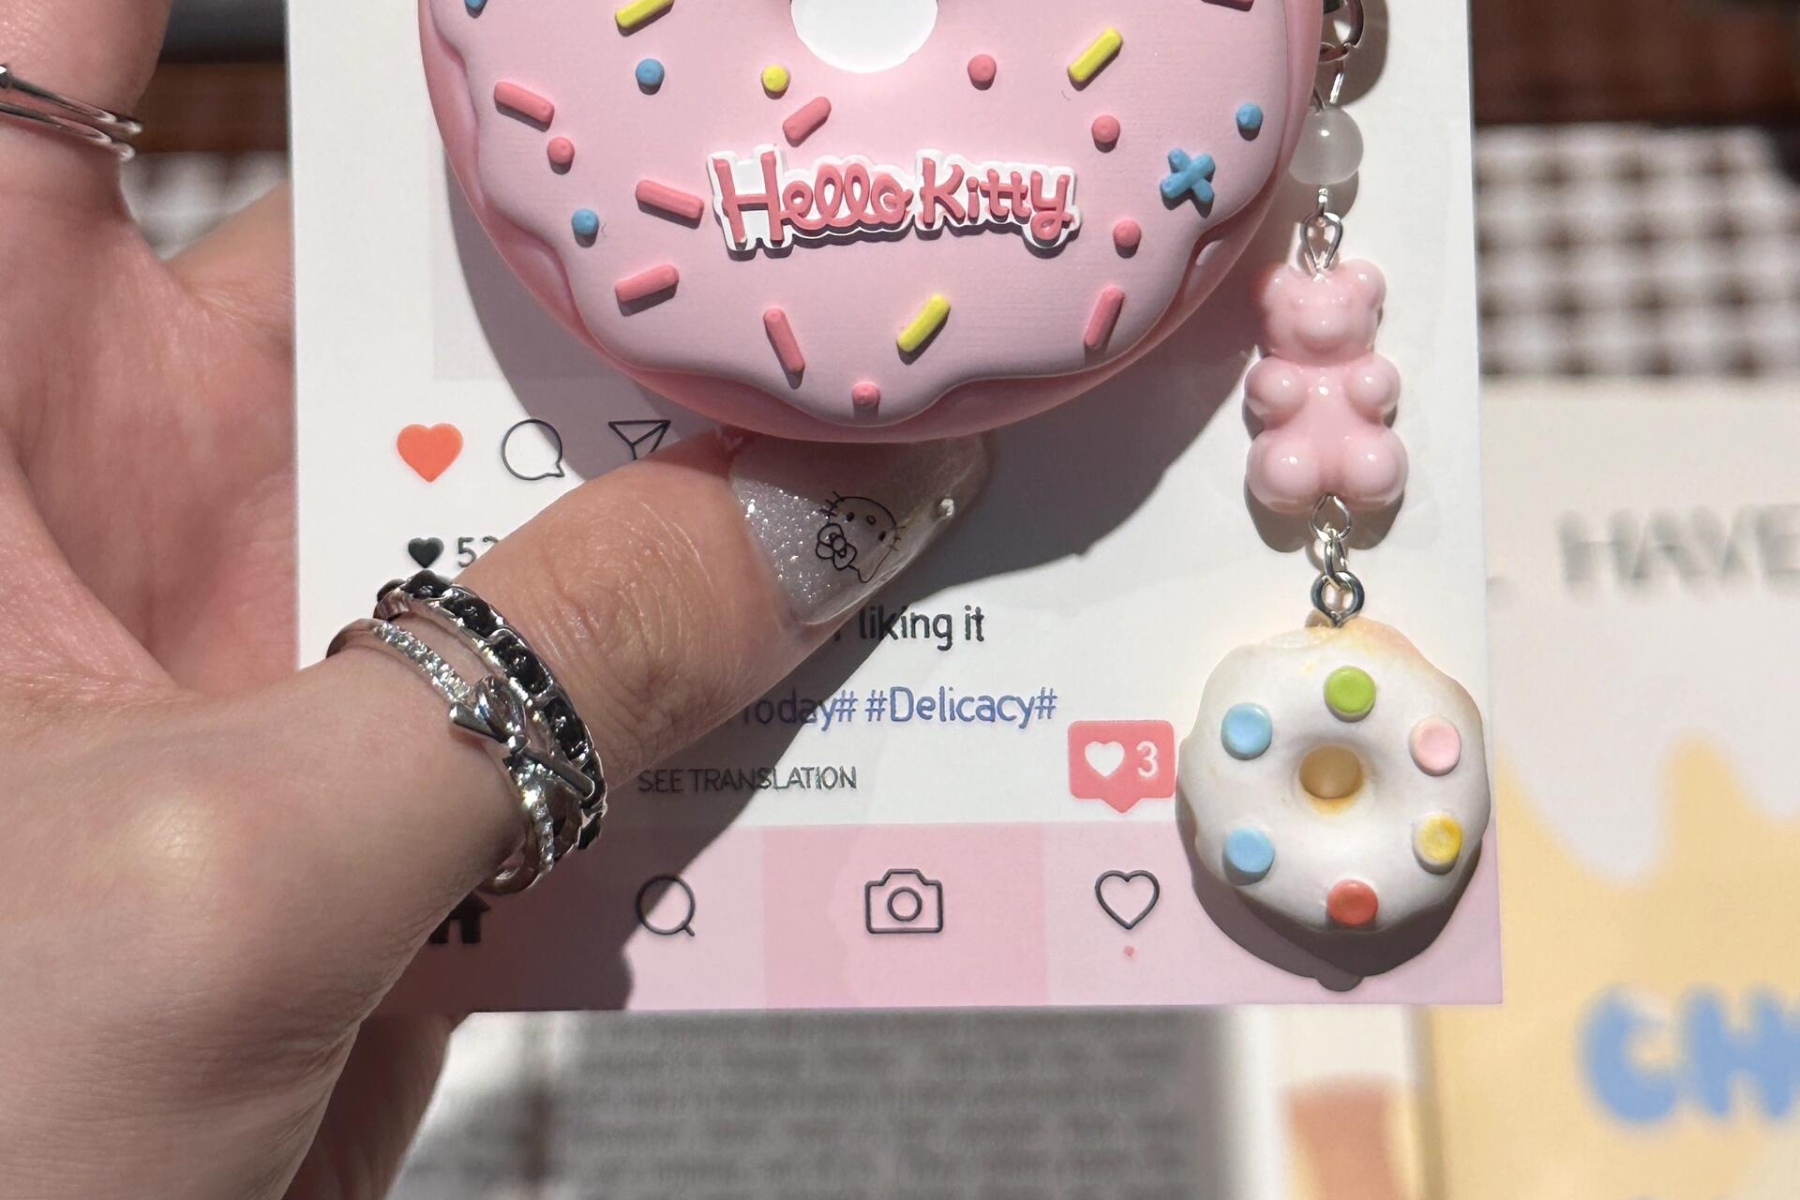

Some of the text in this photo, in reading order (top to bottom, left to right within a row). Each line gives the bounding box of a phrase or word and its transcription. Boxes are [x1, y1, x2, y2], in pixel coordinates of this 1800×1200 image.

[711, 147, 1077, 250] Hello Kitty
[858, 605, 985, 651] liking it
[864, 686, 1058, 729] #Delicacy#
[638, 765, 858, 793] SEE TRANSLATION
[1136, 740, 1158, 778] 3
